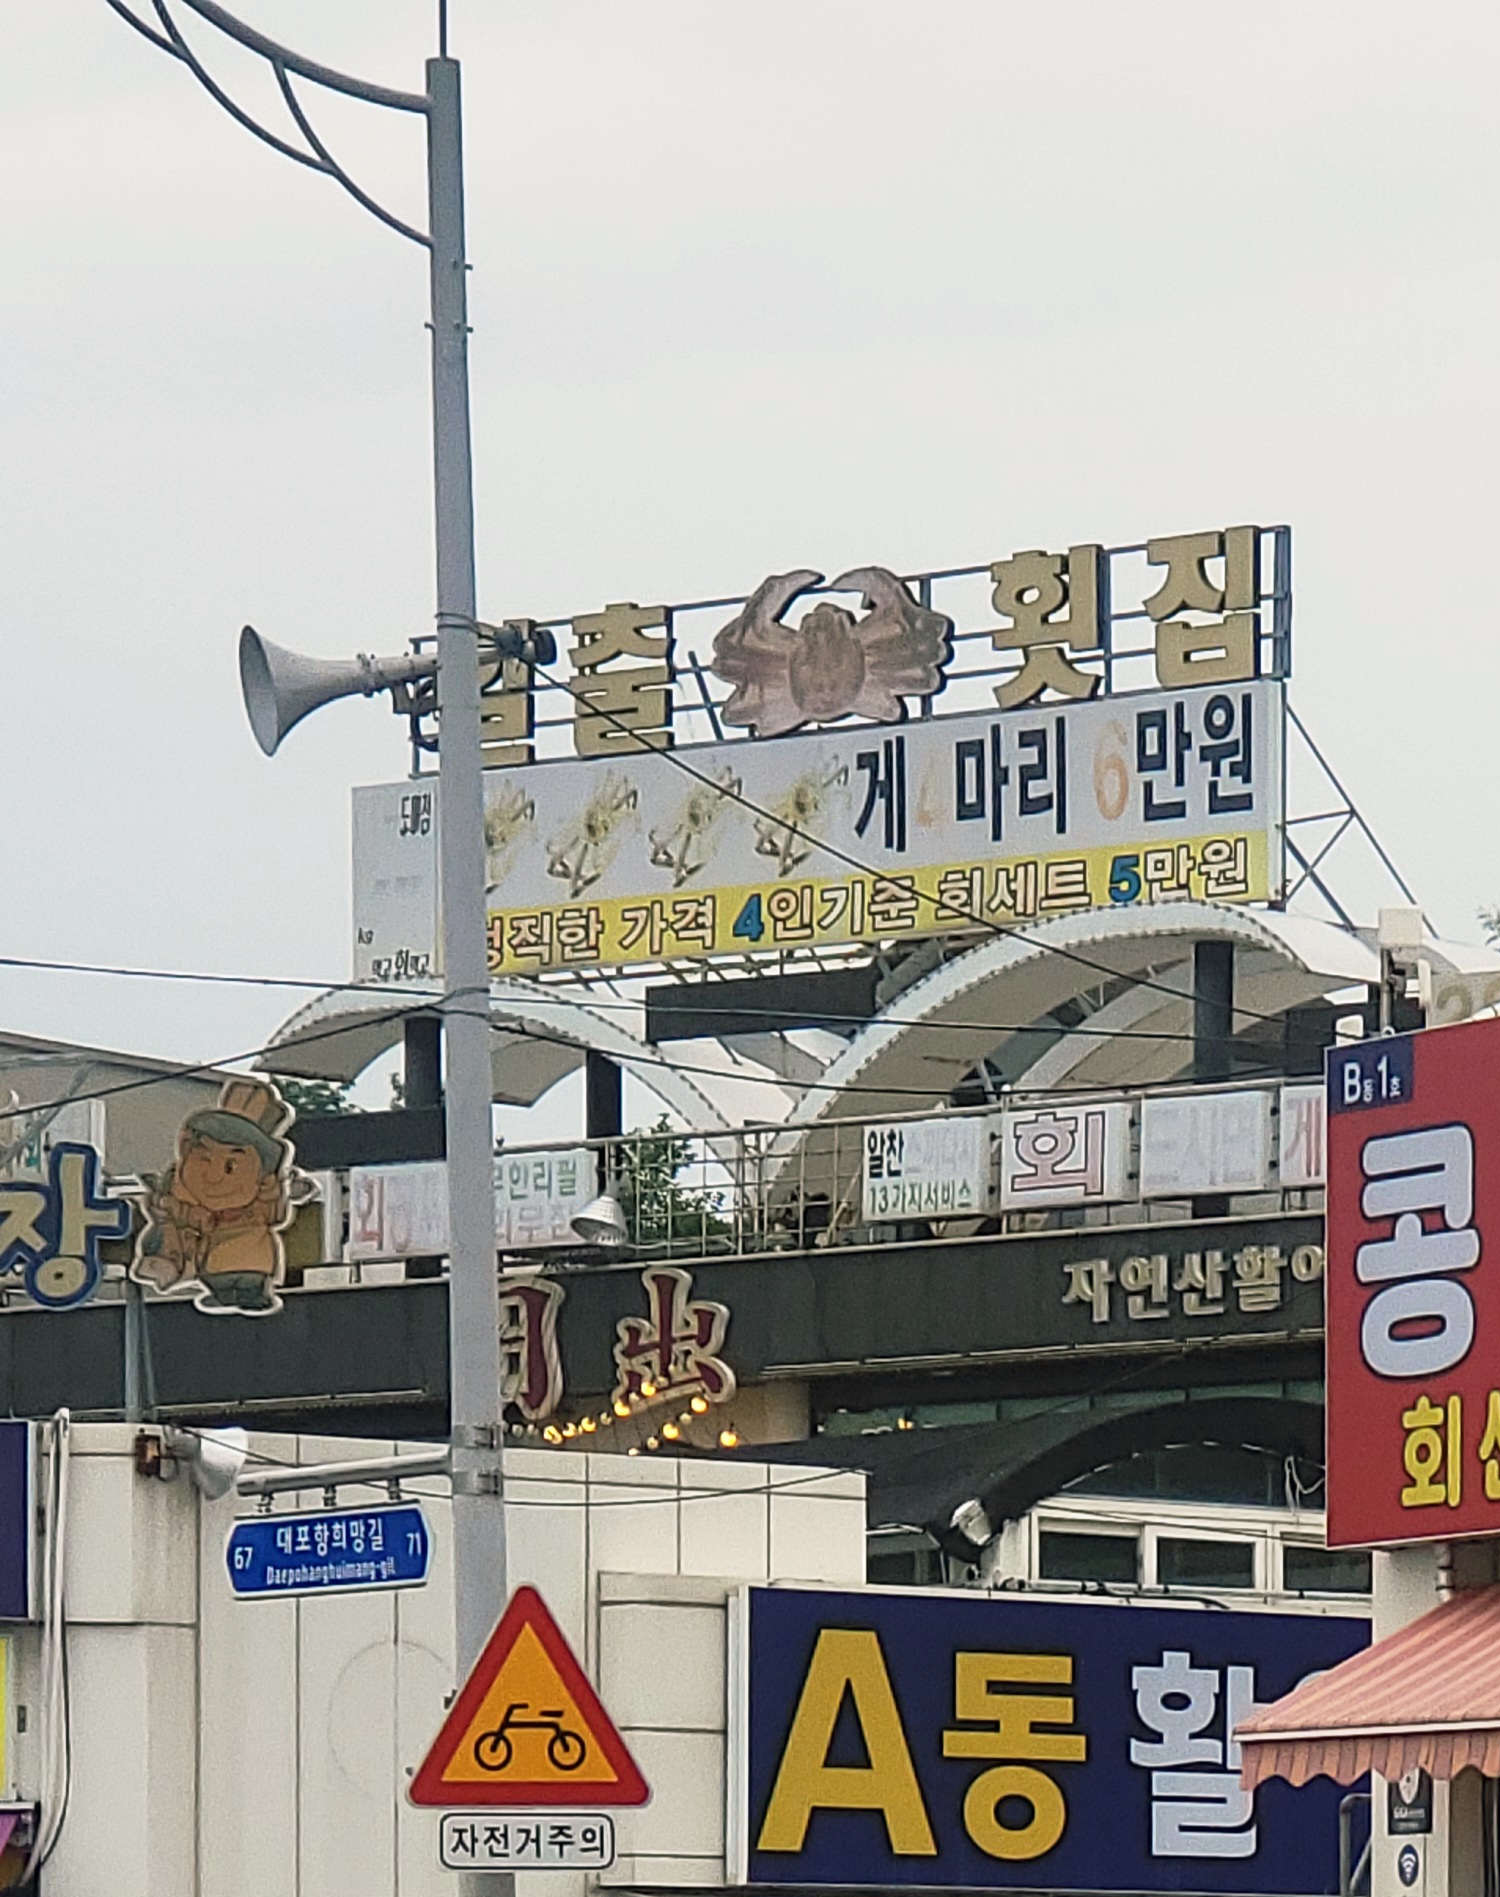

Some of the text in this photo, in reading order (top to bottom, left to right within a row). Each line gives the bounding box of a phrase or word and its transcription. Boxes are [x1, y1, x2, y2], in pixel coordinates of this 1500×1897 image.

[990, 524, 1262, 709] 횟집
[854, 733, 907, 853] 게
[955, 714, 1066, 842] 마리
[1092, 692, 1254, 823] 6만원
[618, 895, 716, 957] 가격
[732, 874, 919, 942] 4인기준
[935, 858, 1092, 920] 회세트
[1109, 837, 1249, 905] 5만원
[1010, 1110, 1106, 1197] 회
[233, 1517, 422, 1570] 67 대포항희망길 71
[756, 1627, 1088, 1862] A동
[1129, 1649, 1330, 1858] 활
[450, 1823, 606, 1859] 자전거주의
